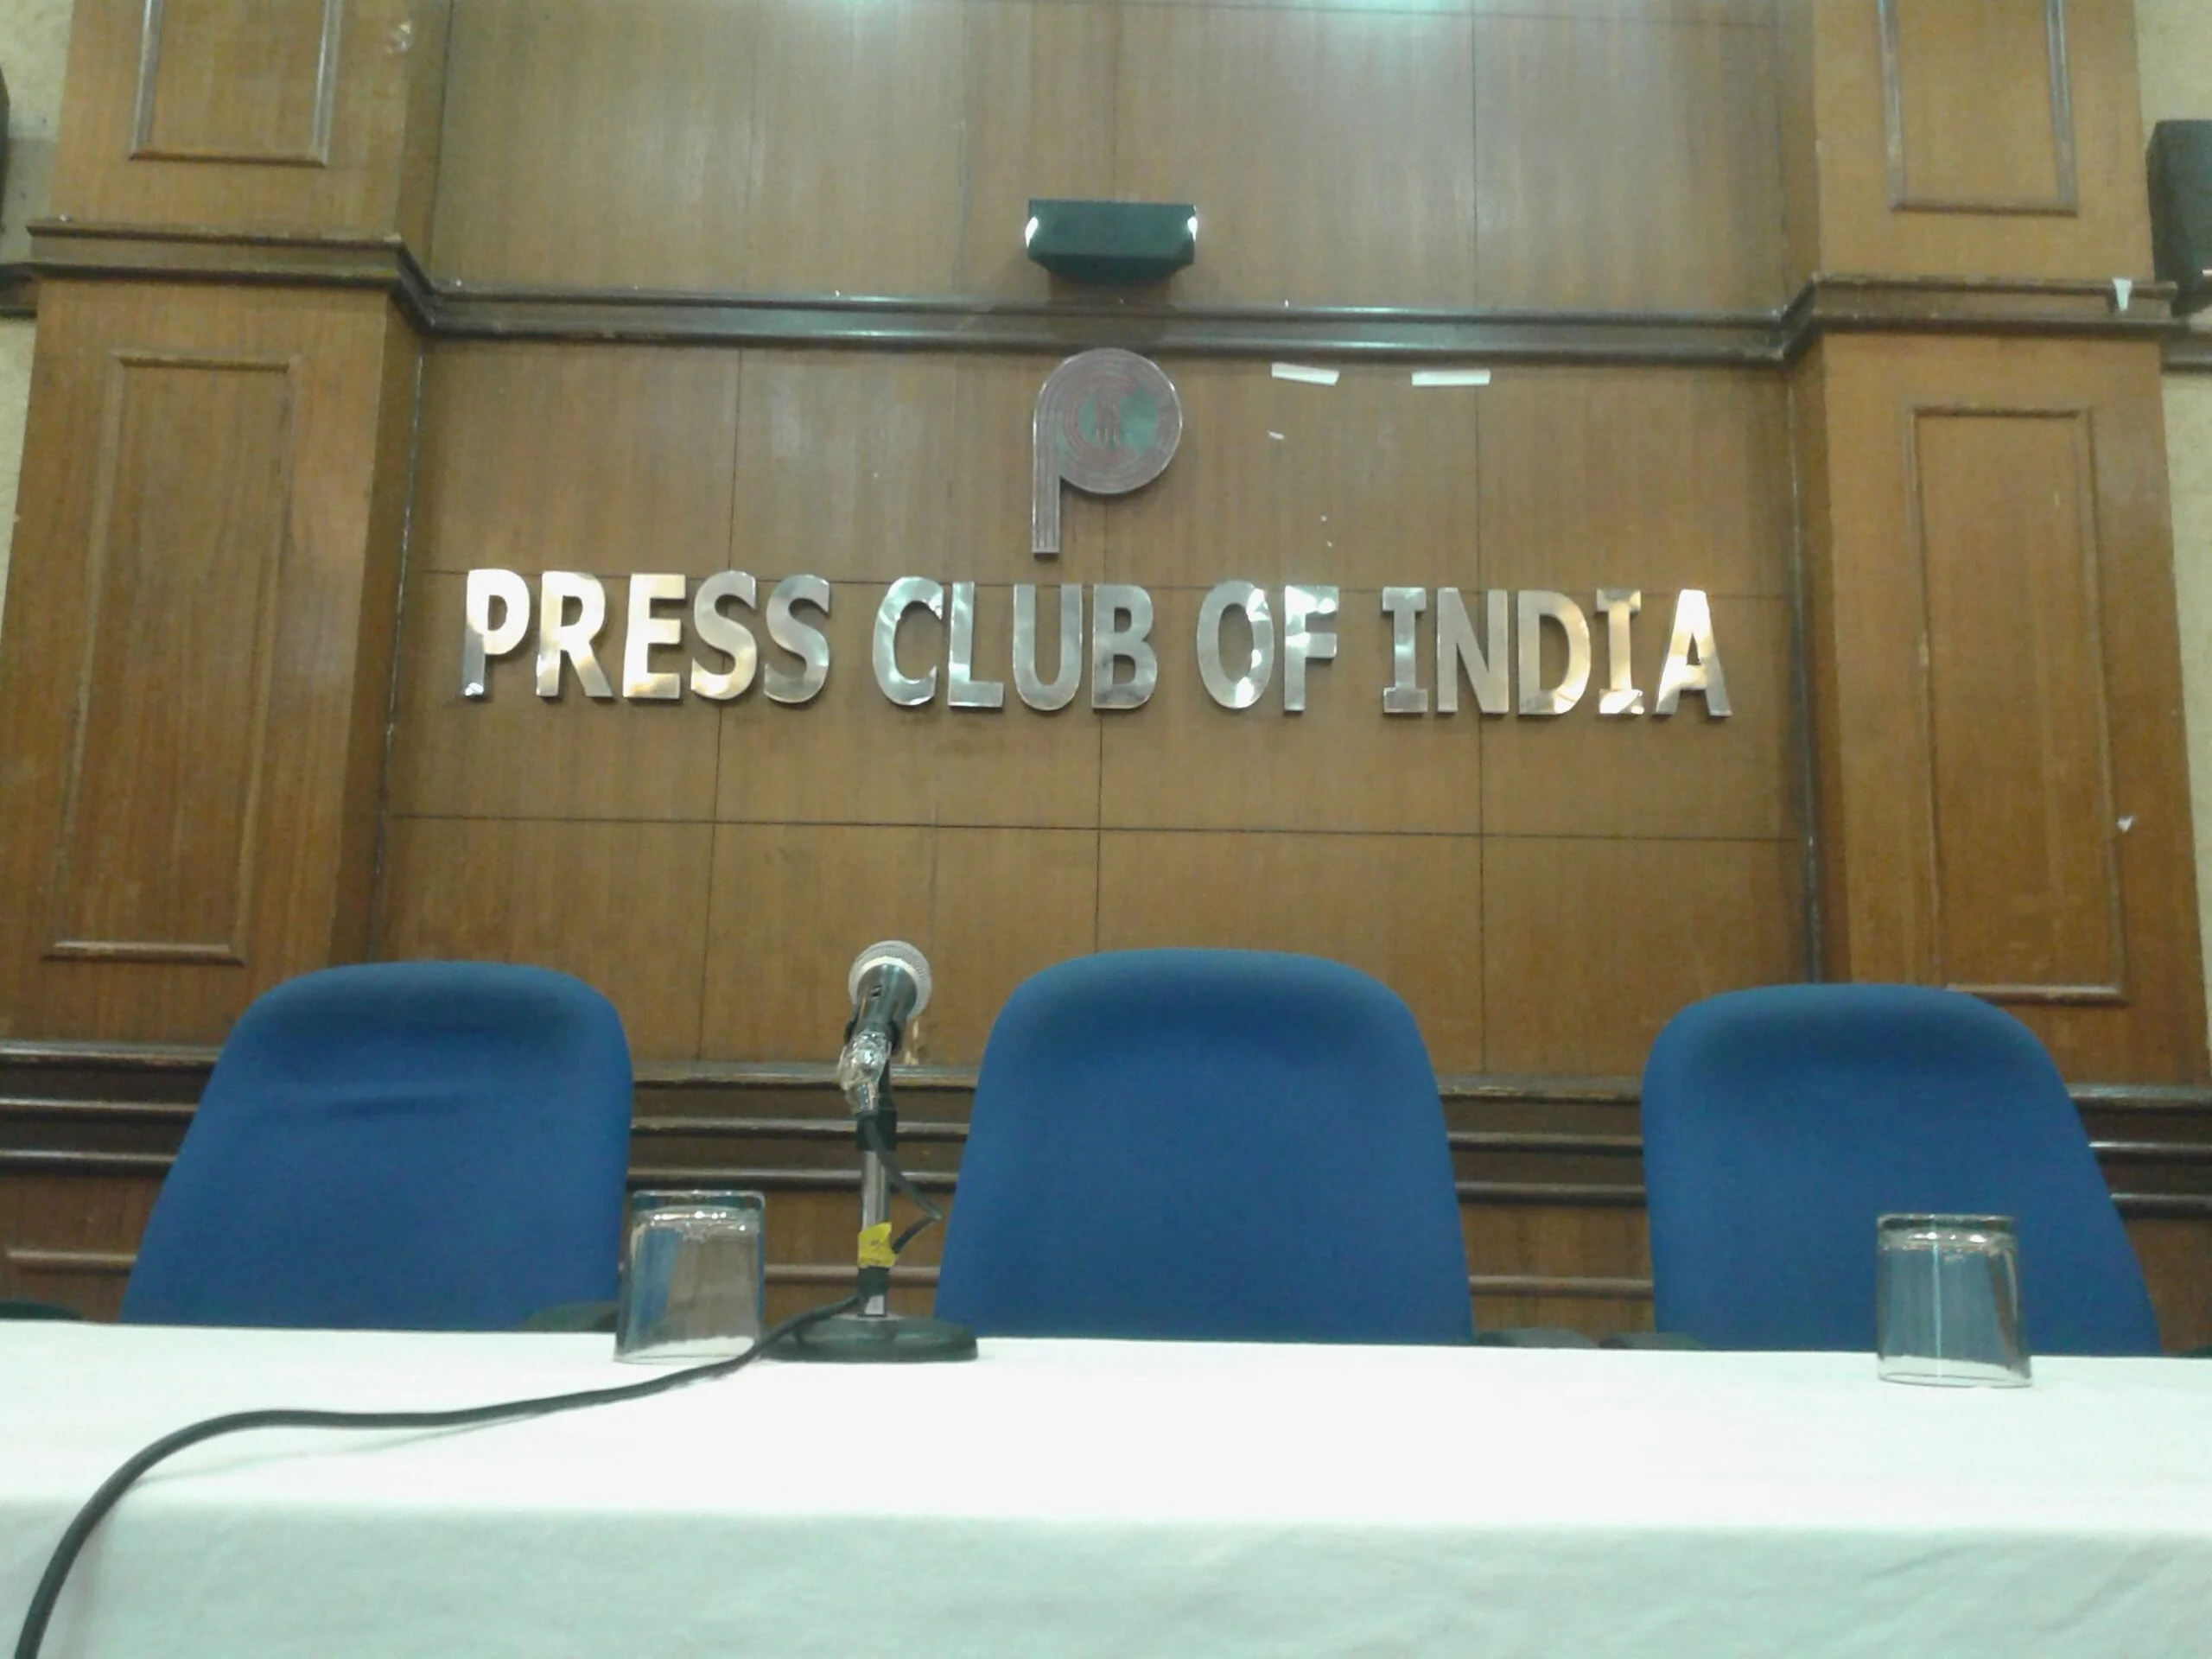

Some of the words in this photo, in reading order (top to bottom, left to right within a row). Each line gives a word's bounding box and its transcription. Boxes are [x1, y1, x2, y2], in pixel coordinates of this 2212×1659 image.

[461, 568, 830, 703] PRESS
[872, 576, 1158, 711] CLUB
[1197, 580, 1338, 711] OF
[1382, 587, 1732, 716] INDIA
